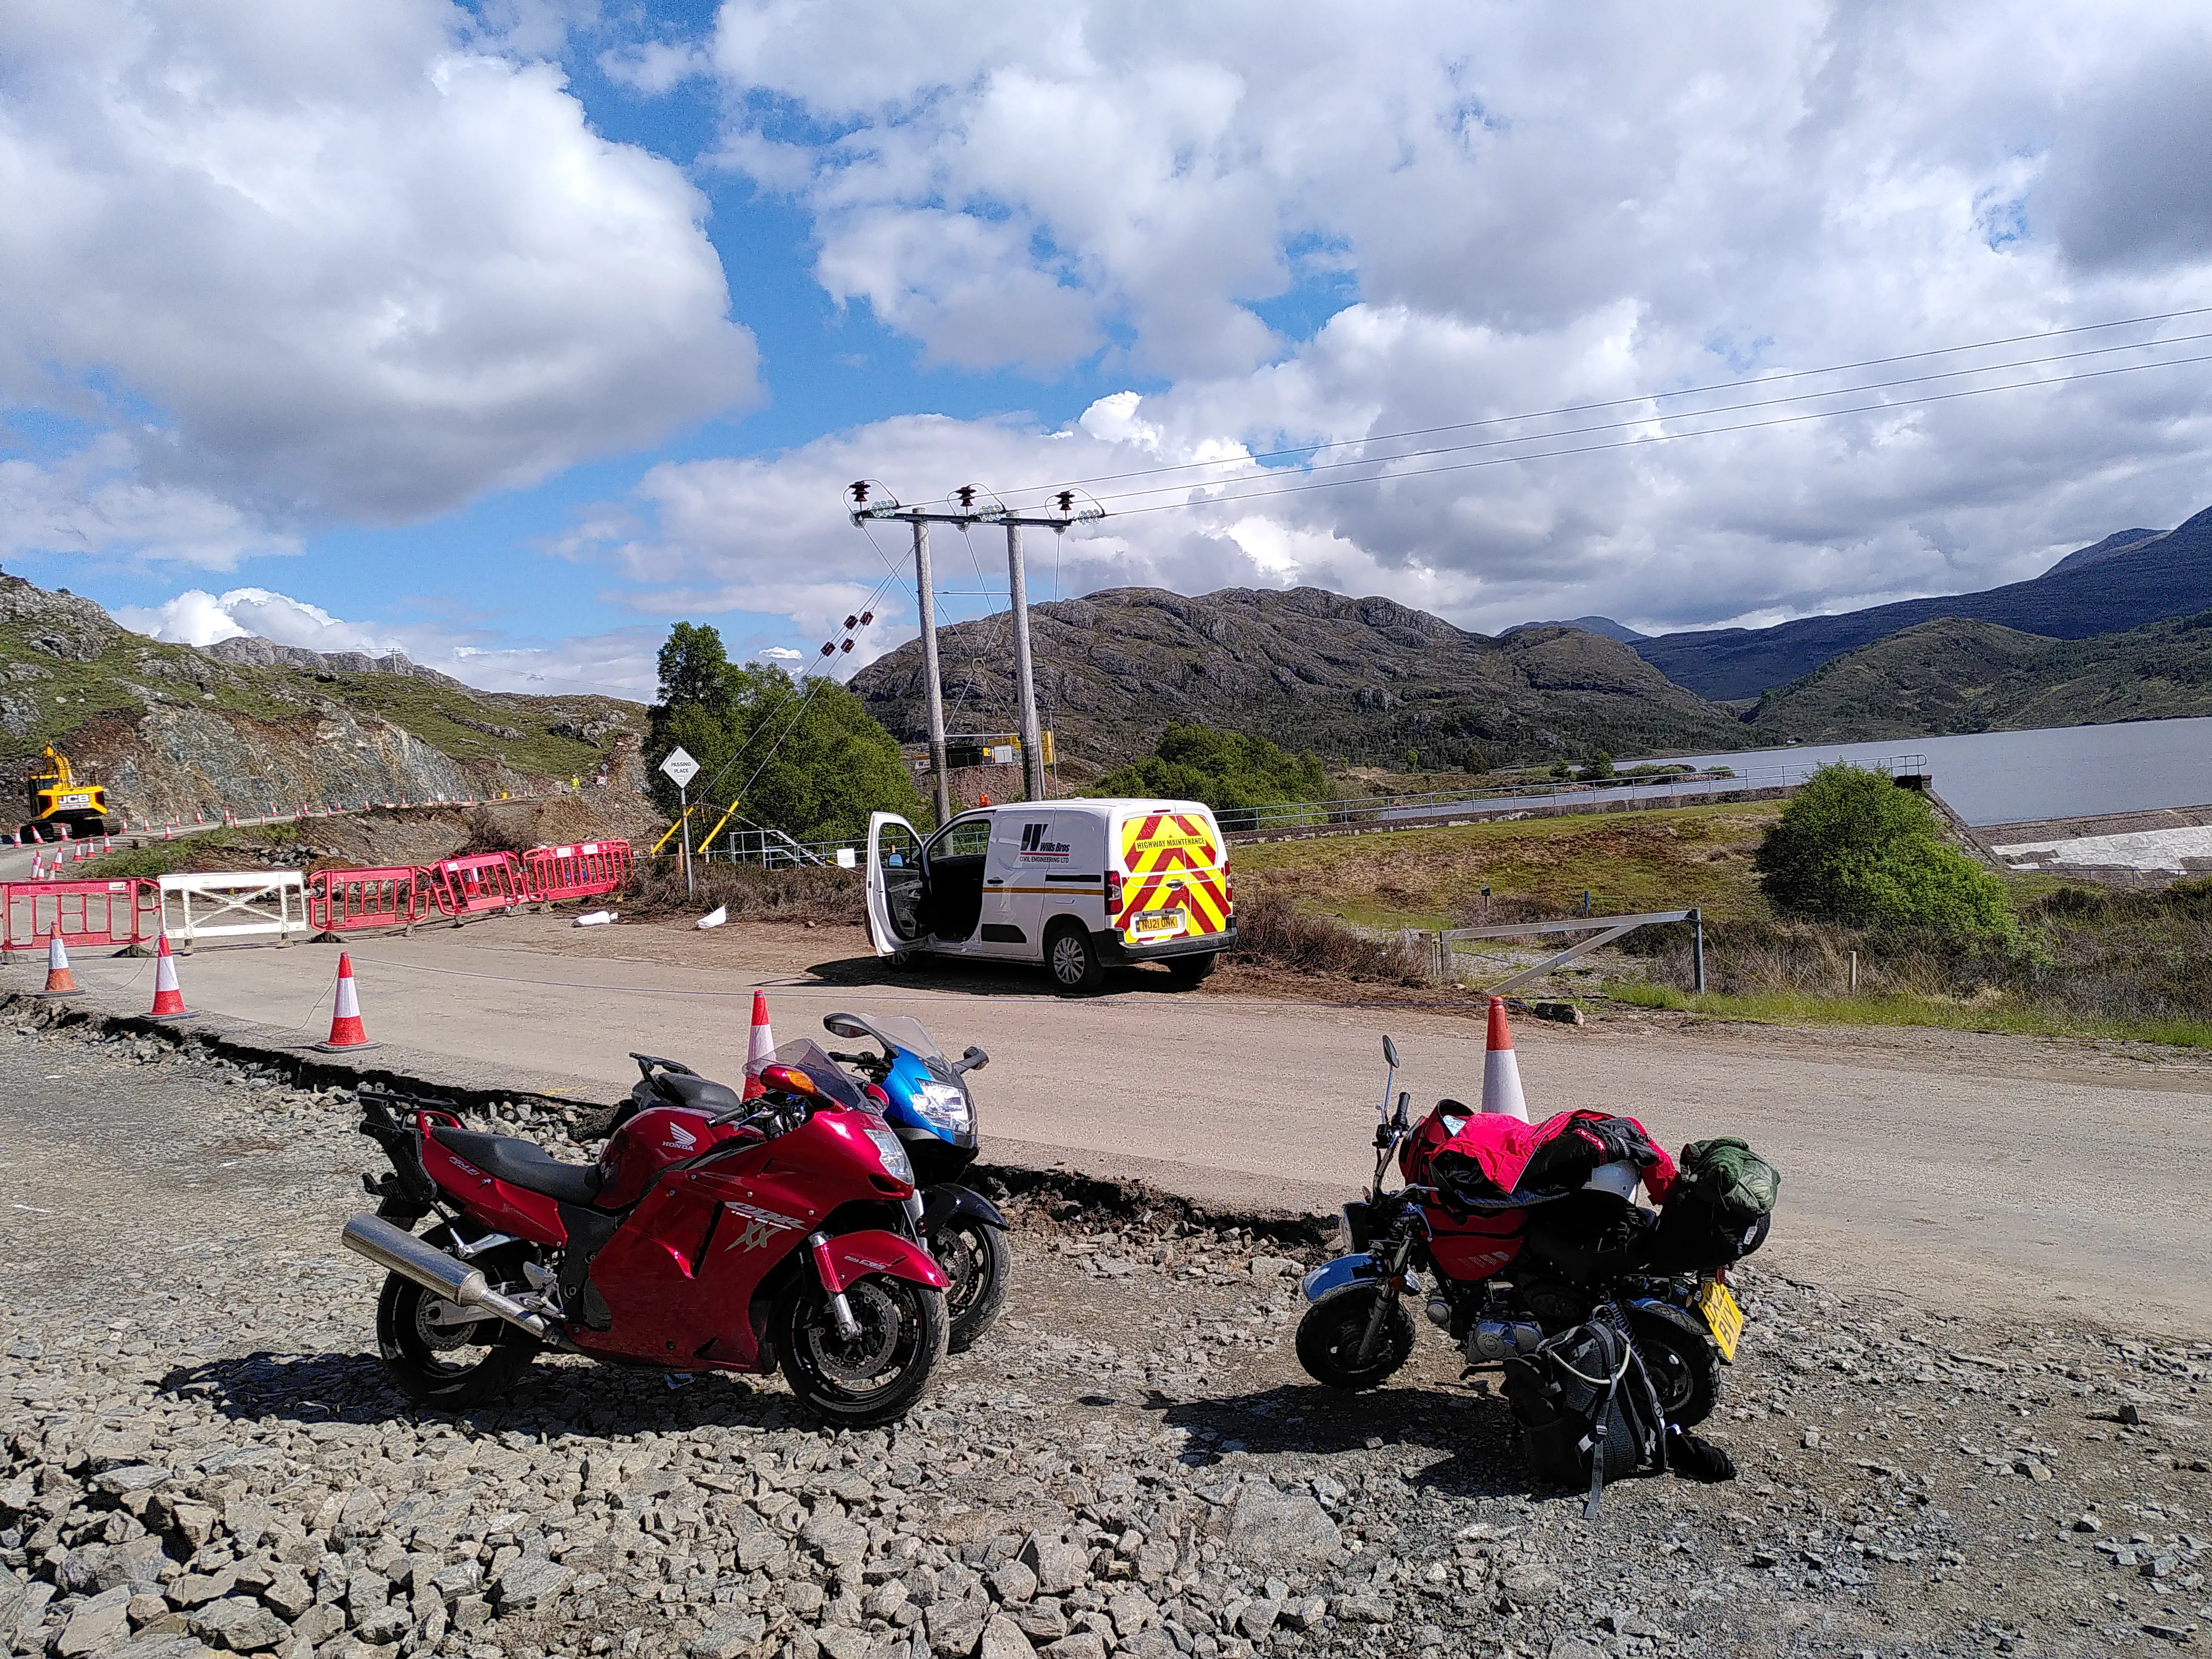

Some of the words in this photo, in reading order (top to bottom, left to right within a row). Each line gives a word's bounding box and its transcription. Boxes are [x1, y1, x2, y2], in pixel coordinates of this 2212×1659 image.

[58, 795, 90, 804] JCB
[1040, 842, 1056, 852] Wills
[1055, 842, 1070, 852] Bros
[1136, 840, 1166, 849] HIGHWAY
[1167, 837, 1205, 847] MAINTENANCE
[1142, 919, 1160, 930] NU21
[661, 1141, 695, 1151] HONDA
